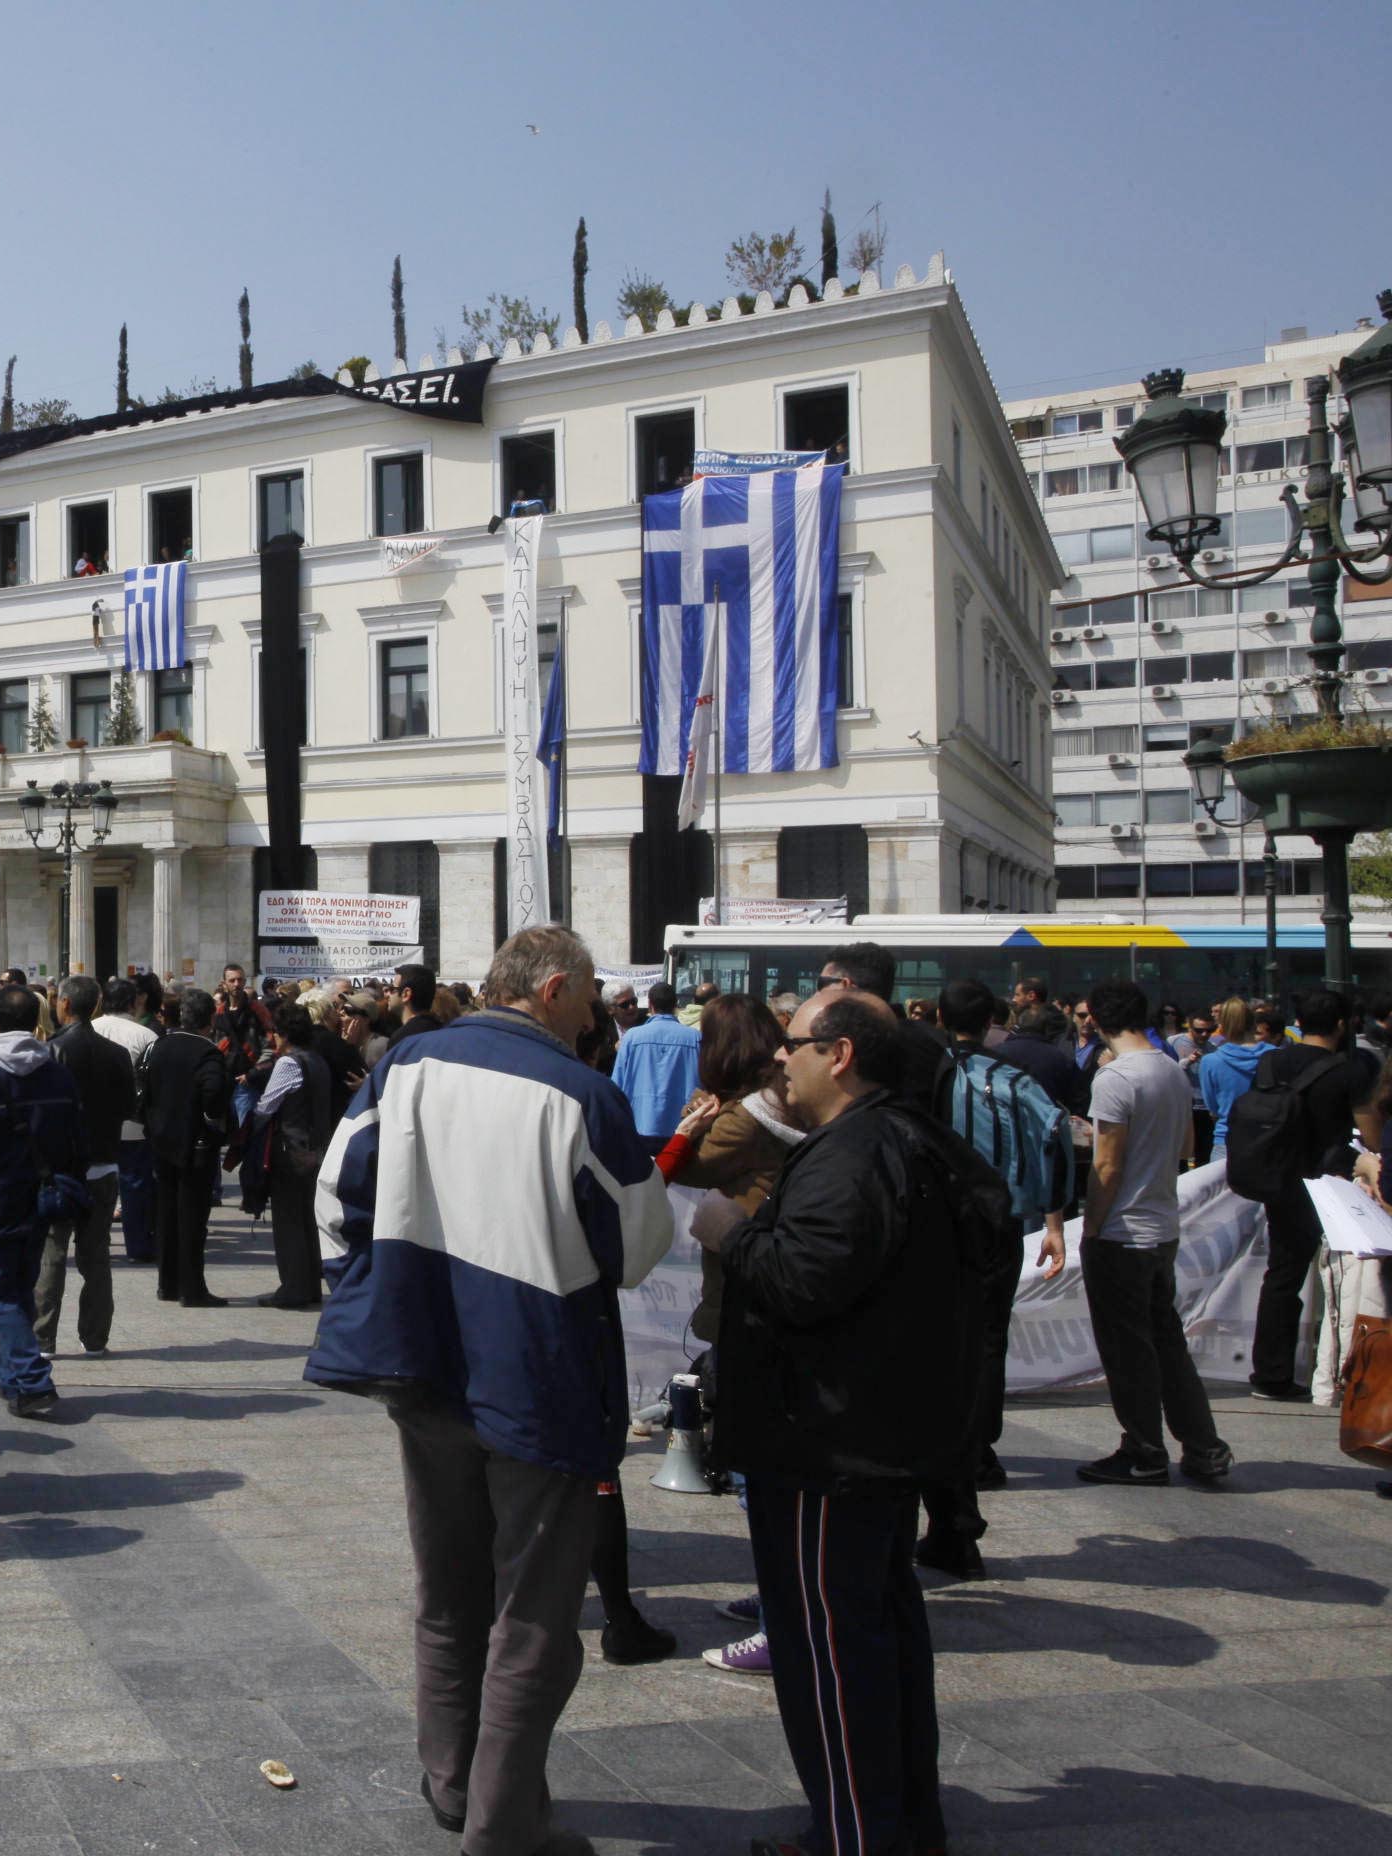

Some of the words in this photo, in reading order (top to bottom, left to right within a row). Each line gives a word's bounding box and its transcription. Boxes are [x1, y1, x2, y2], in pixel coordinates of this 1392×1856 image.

[512, 520, 531, 699] ΚΑΤΑΛΗΨΗ
[513, 734, 536, 930] ΣΥΜΒΑΣΙΟΥ
[267, 897, 284, 906] ΕΔΩ
[288, 897, 303, 906] ΚΑΙ
[306, 897, 327, 906] ΤΩΡΑ
[330, 898, 408, 910] ΜΟΝΙΜΟΠΟΙΗΣΗ
[336, 909, 392, 919] ΕΜΠΑΙΓΜΟ
[337, 919, 366, 927] ΔΟΥΛΕΙΑ
[278, 946, 298, 954] ΝΑΙ
[328, 946, 404, 955] ΤΑΚΤΟΠΟΙΗΣΗ
[288, 957, 307, 966] ΟΧΙ
